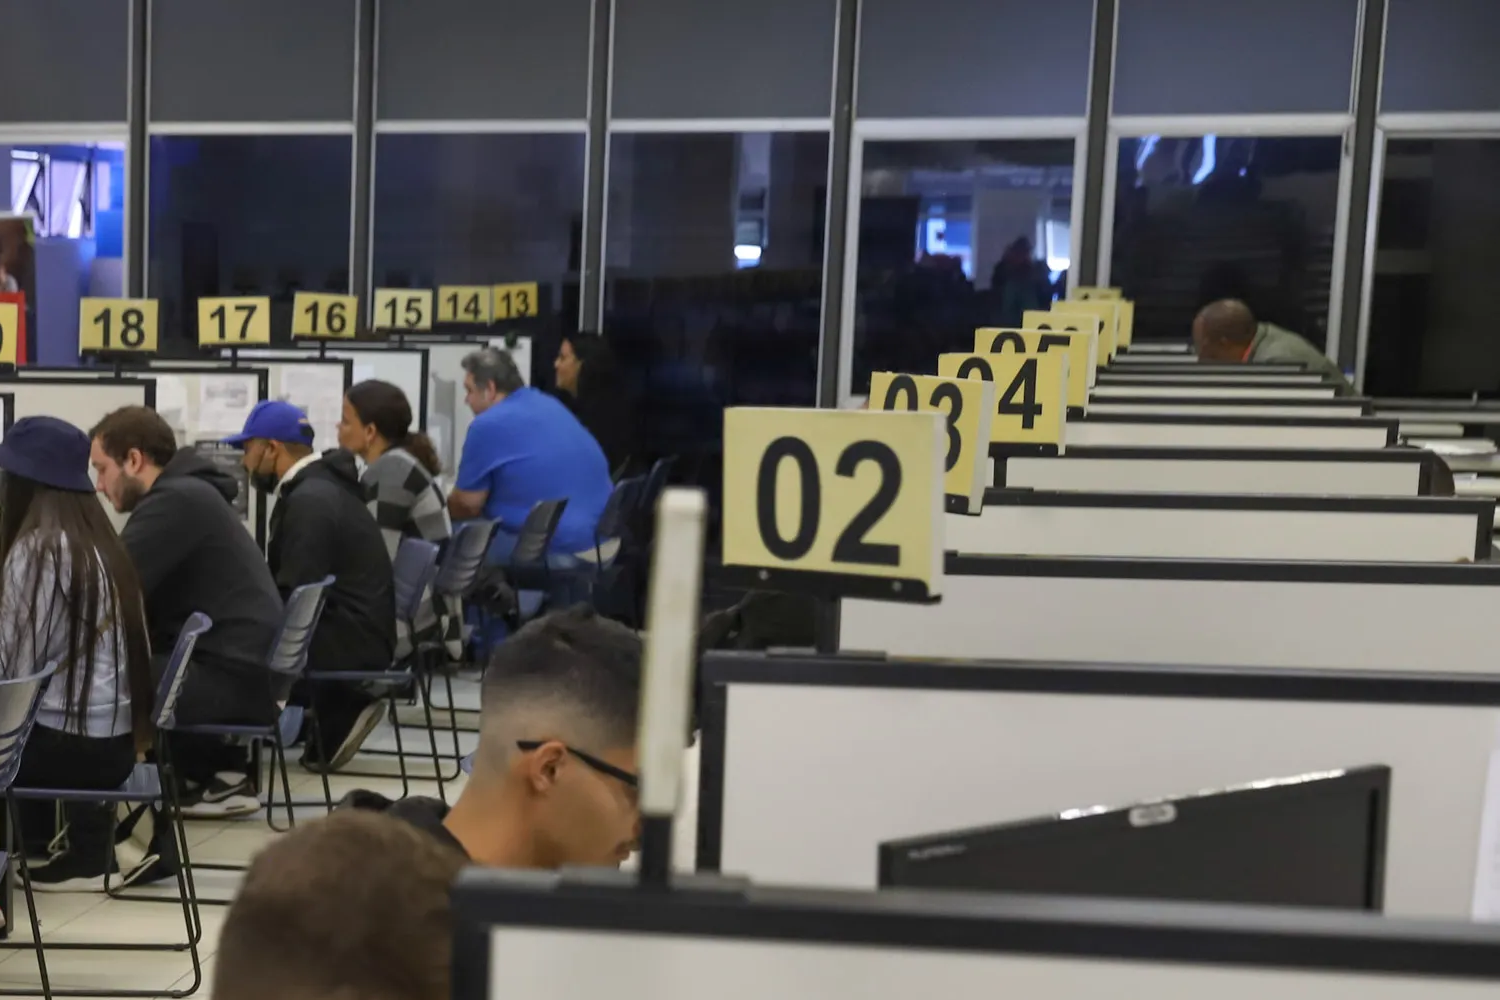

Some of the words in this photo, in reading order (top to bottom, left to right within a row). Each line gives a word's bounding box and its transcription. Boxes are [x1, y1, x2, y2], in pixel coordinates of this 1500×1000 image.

[304, 300, 347, 335] 16
[384, 297, 423, 329] 15
[447, 292, 482, 321] 14
[502, 289, 530, 318] 13
[93, 307, 146, 348] 18
[210, 304, 258, 341] 17
[757, 436, 903, 567] 02
